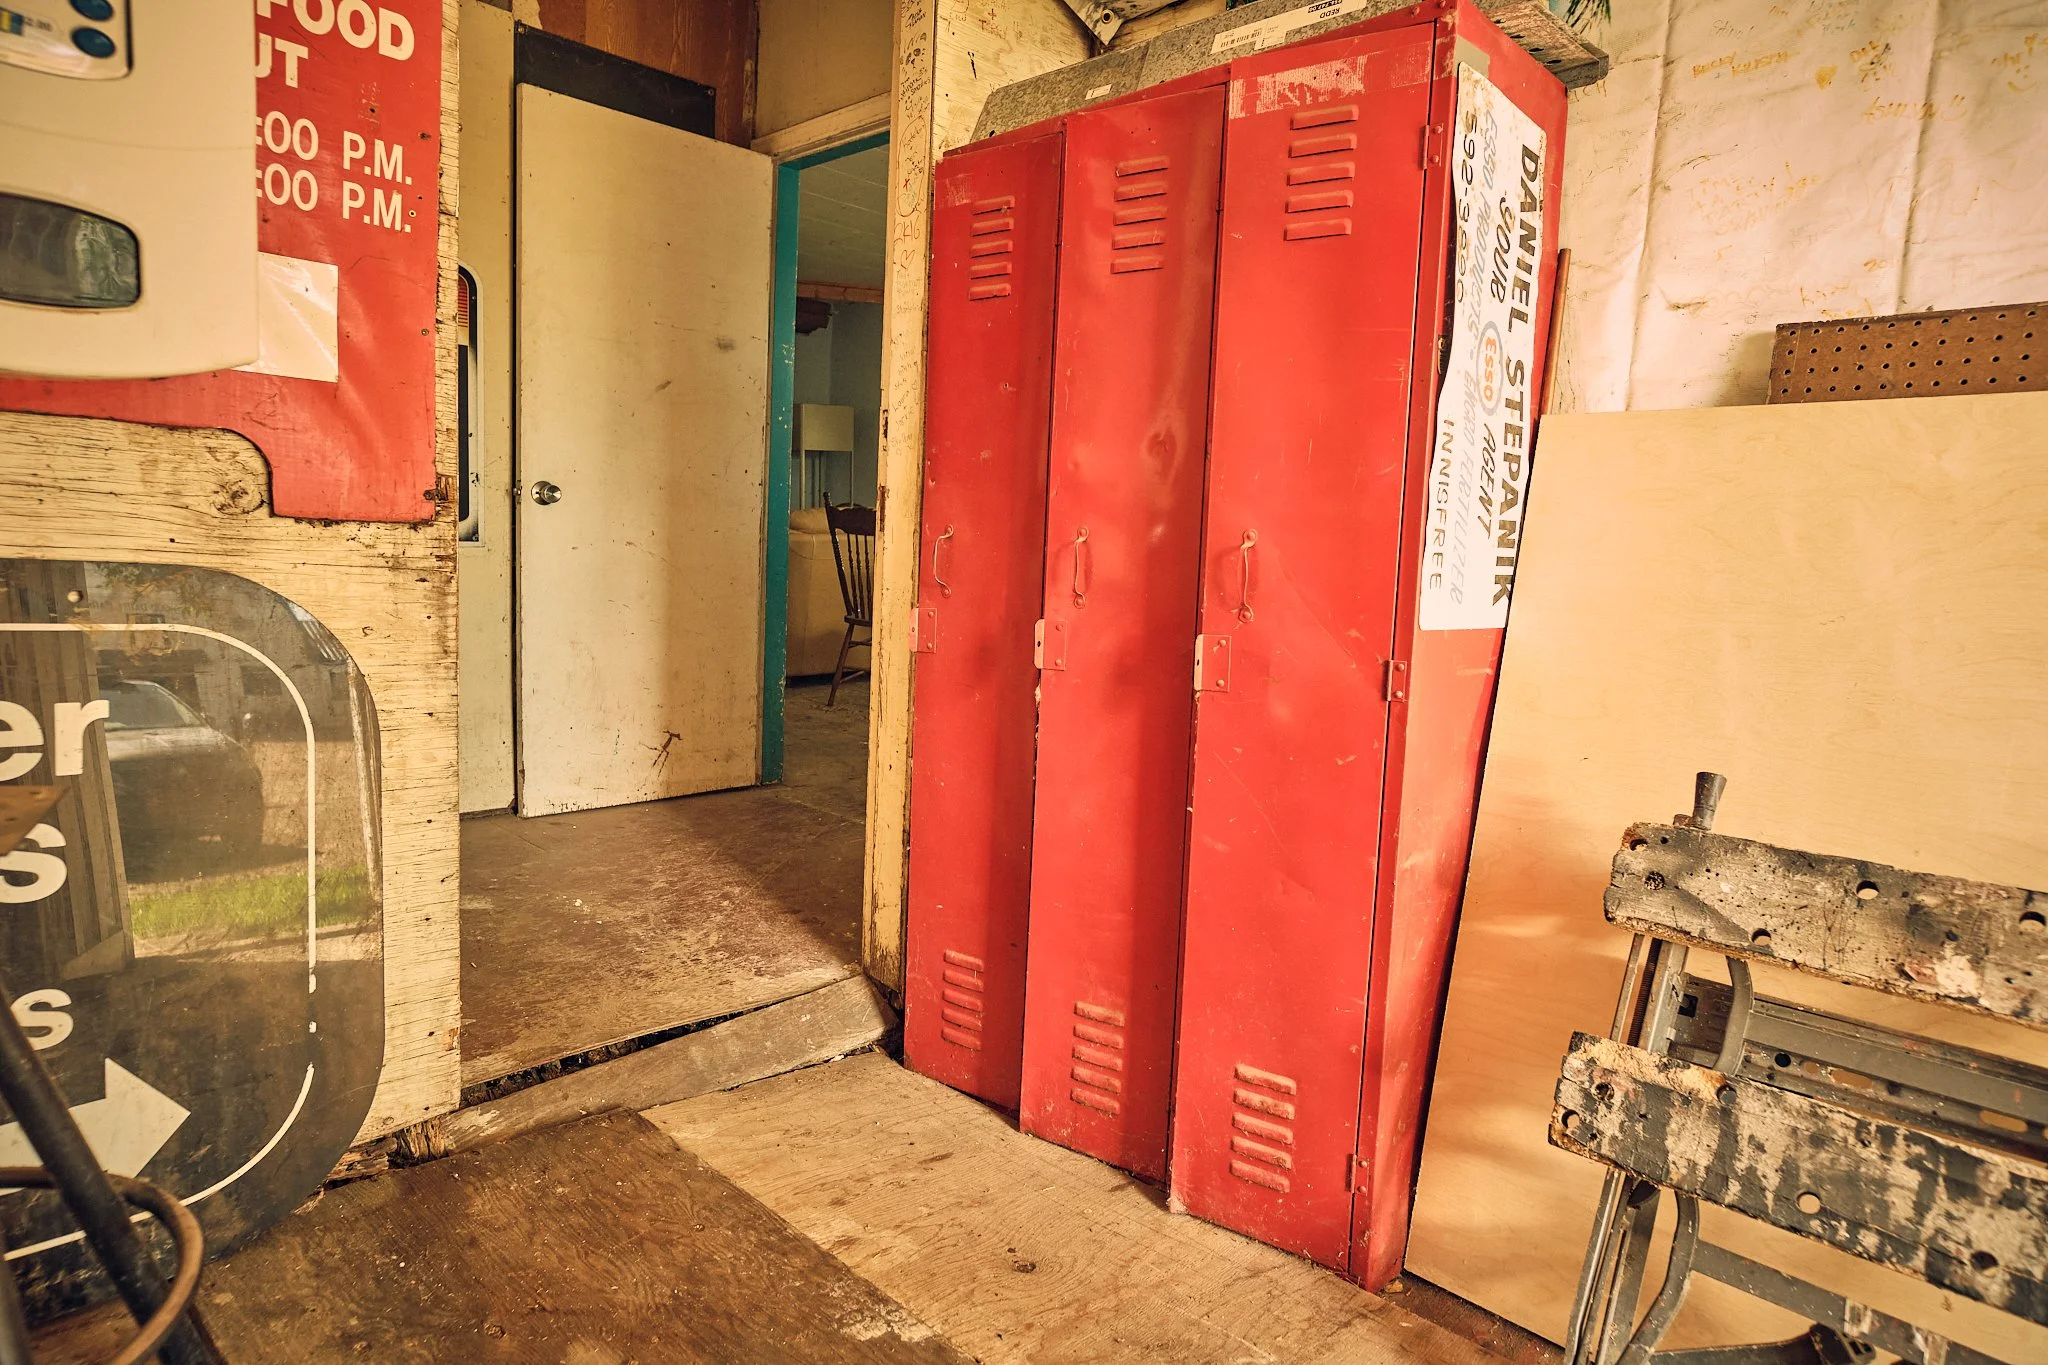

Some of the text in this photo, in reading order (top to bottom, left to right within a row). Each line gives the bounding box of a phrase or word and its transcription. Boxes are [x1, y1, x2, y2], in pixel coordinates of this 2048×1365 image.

[342, 180, 412, 234] P.M.
[343, 130, 413, 186] P.M.
[1467, 191, 1492, 342] PRODUCTS
[1477, 196, 1516, 540] YOUR AGENT
[1492, 143, 1541, 607] DANIEL STEPANIK
[1428, 418, 1455, 592] INNISFREE
